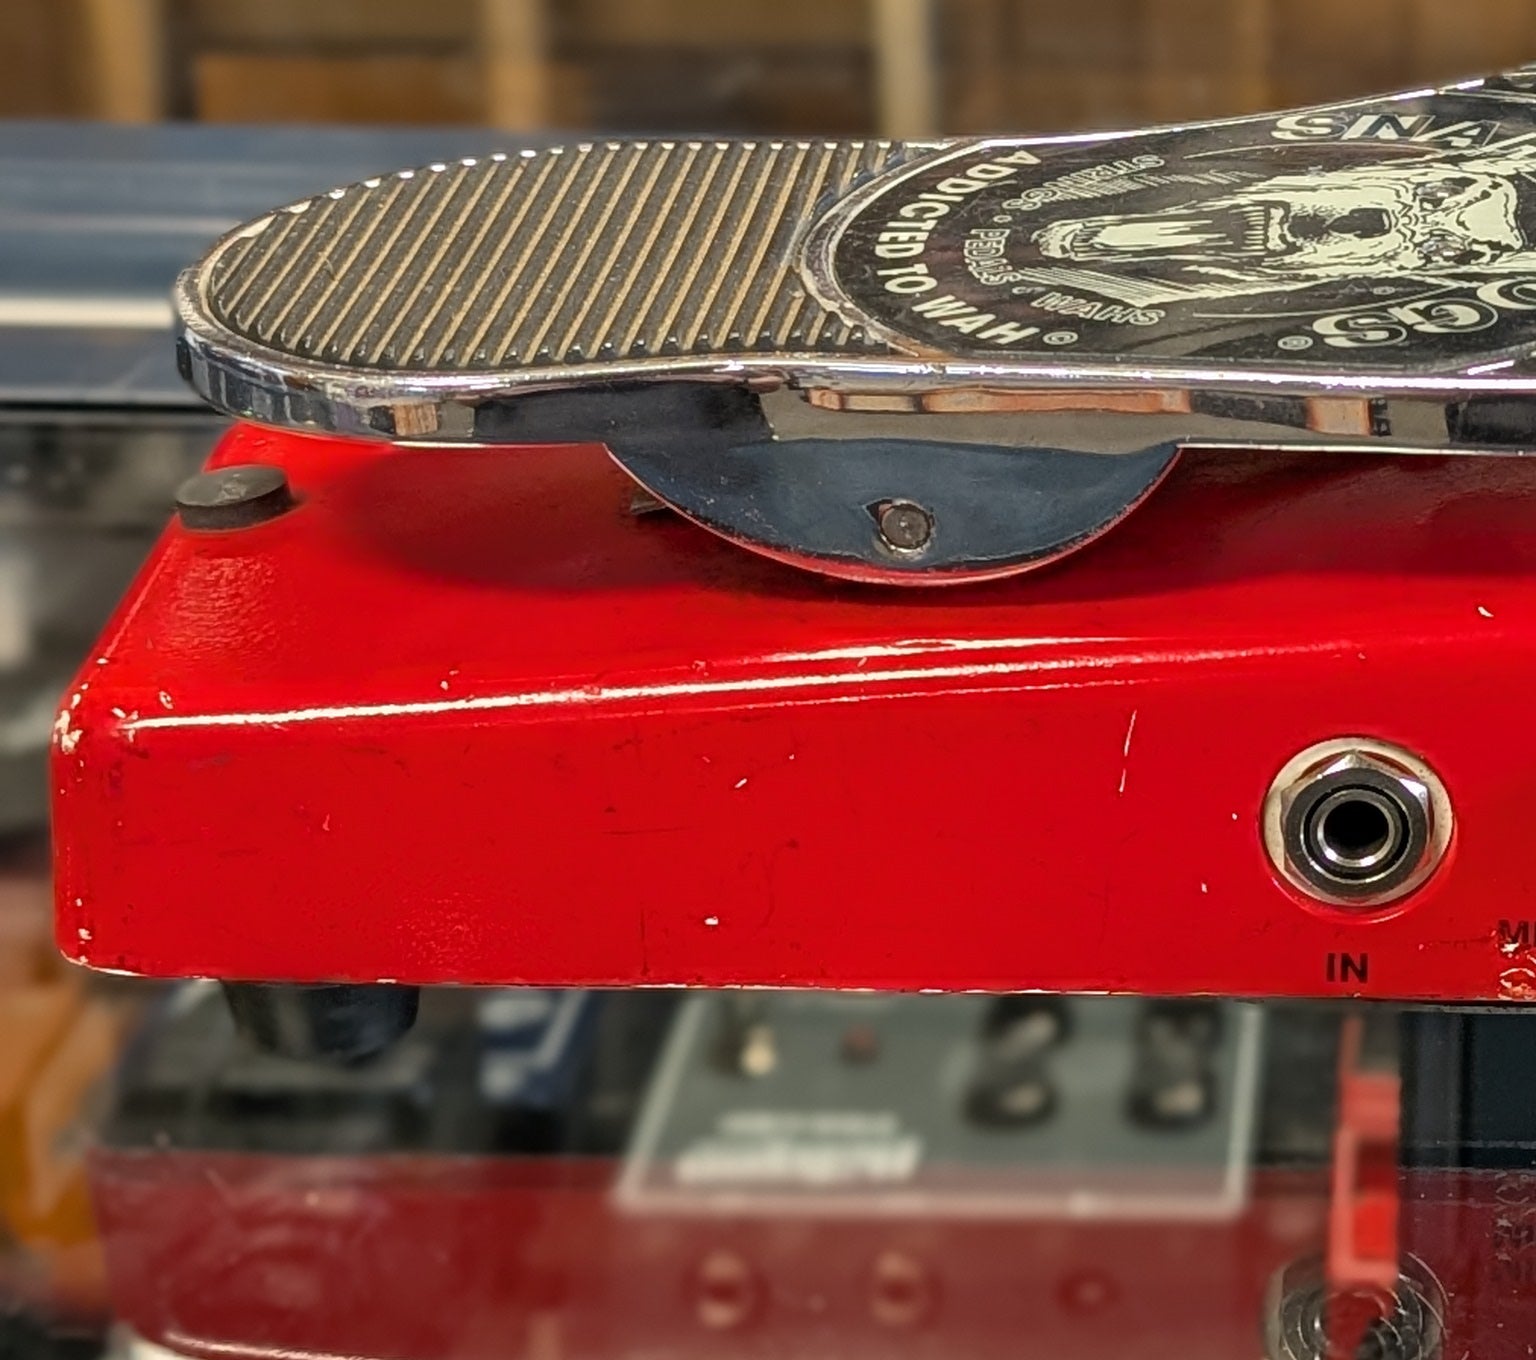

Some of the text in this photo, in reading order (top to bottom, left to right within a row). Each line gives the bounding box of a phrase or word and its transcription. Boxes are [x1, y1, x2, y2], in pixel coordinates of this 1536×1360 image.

[874, 150, 1042, 345] ADDICTED TO WAH
[1326, 952, 1368, 983] IN
